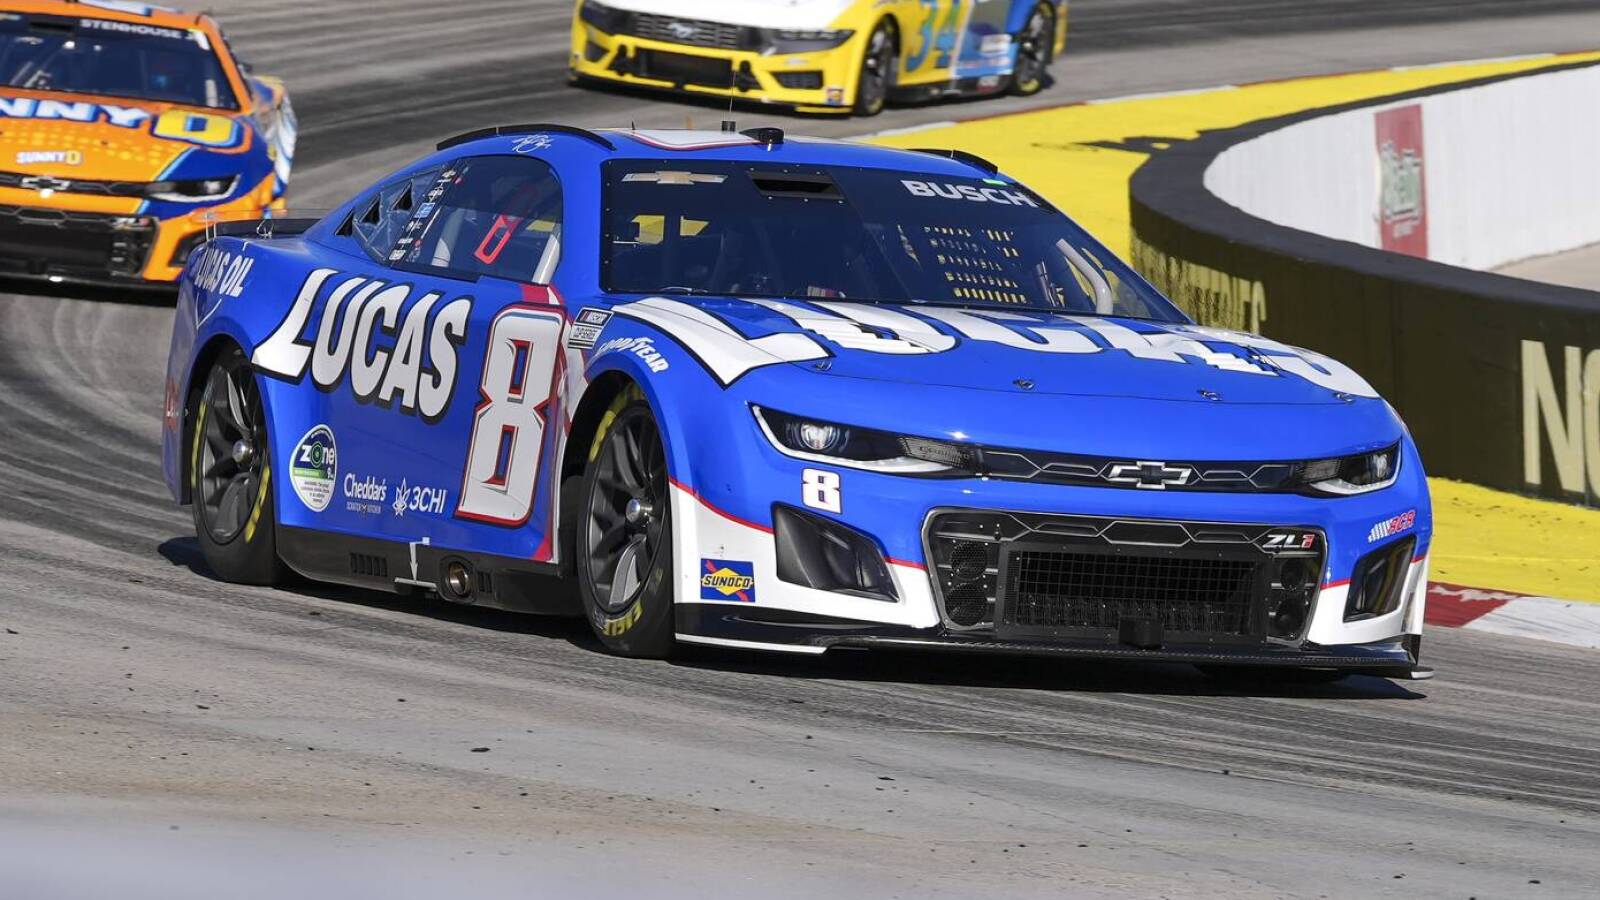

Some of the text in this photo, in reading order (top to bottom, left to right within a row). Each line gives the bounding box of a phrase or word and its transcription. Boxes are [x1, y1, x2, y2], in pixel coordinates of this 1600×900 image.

[80, 19, 182, 39] STENHOUSE
[900, 180, 1039, 208] BUSCH
[219, 255, 254, 297] OIL
[251, 268, 473, 418] LUCAS
[454, 302, 566, 526] 8
[1520, 339, 1600, 498] N
[344, 472, 387, 502] Cheddar's
[409, 485, 448, 514] 3CHI
[802, 468, 842, 514] 8
[1262, 533, 1315, 549] ZL1
[703, 575, 751, 588] SUNOCO
